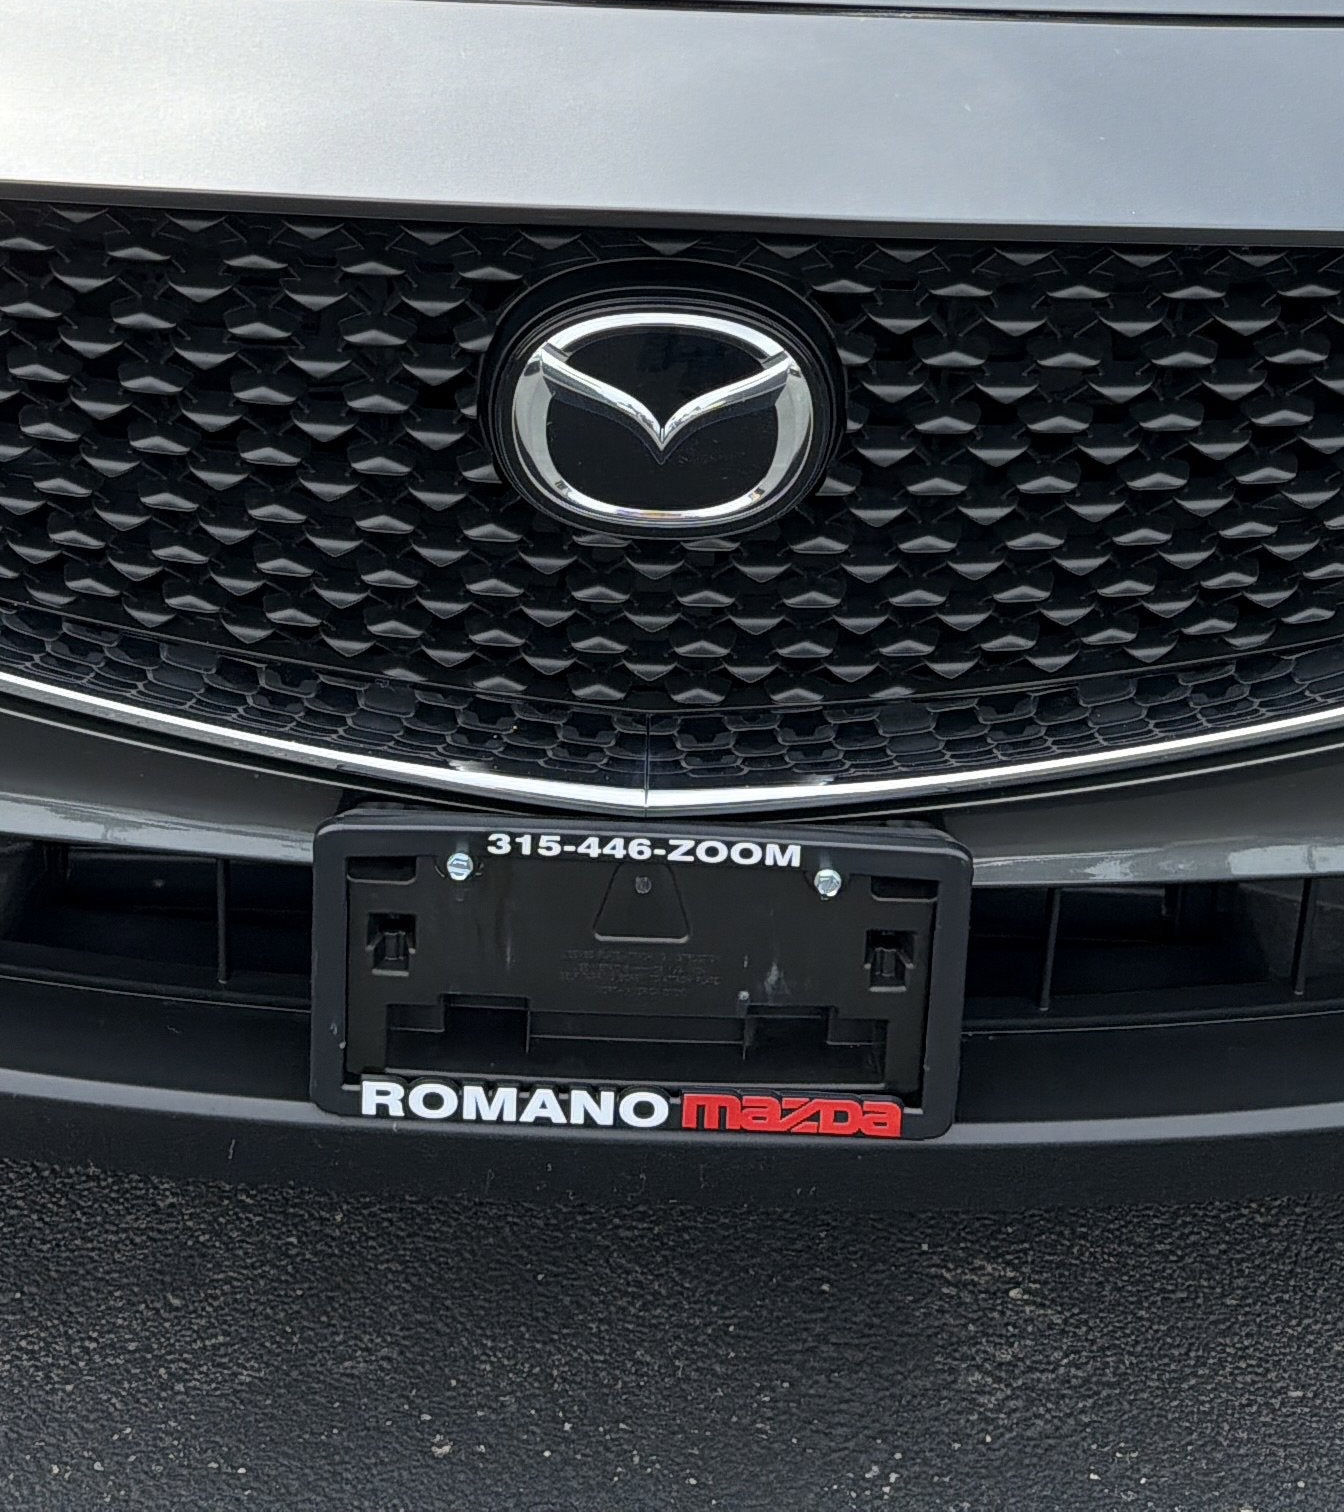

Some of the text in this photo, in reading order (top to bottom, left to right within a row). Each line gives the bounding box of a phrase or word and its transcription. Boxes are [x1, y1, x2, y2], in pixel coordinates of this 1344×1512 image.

[487, 833, 802, 868] 315-446-ZOOM
[361, 1080, 902, 1138] ROMANO mazda
